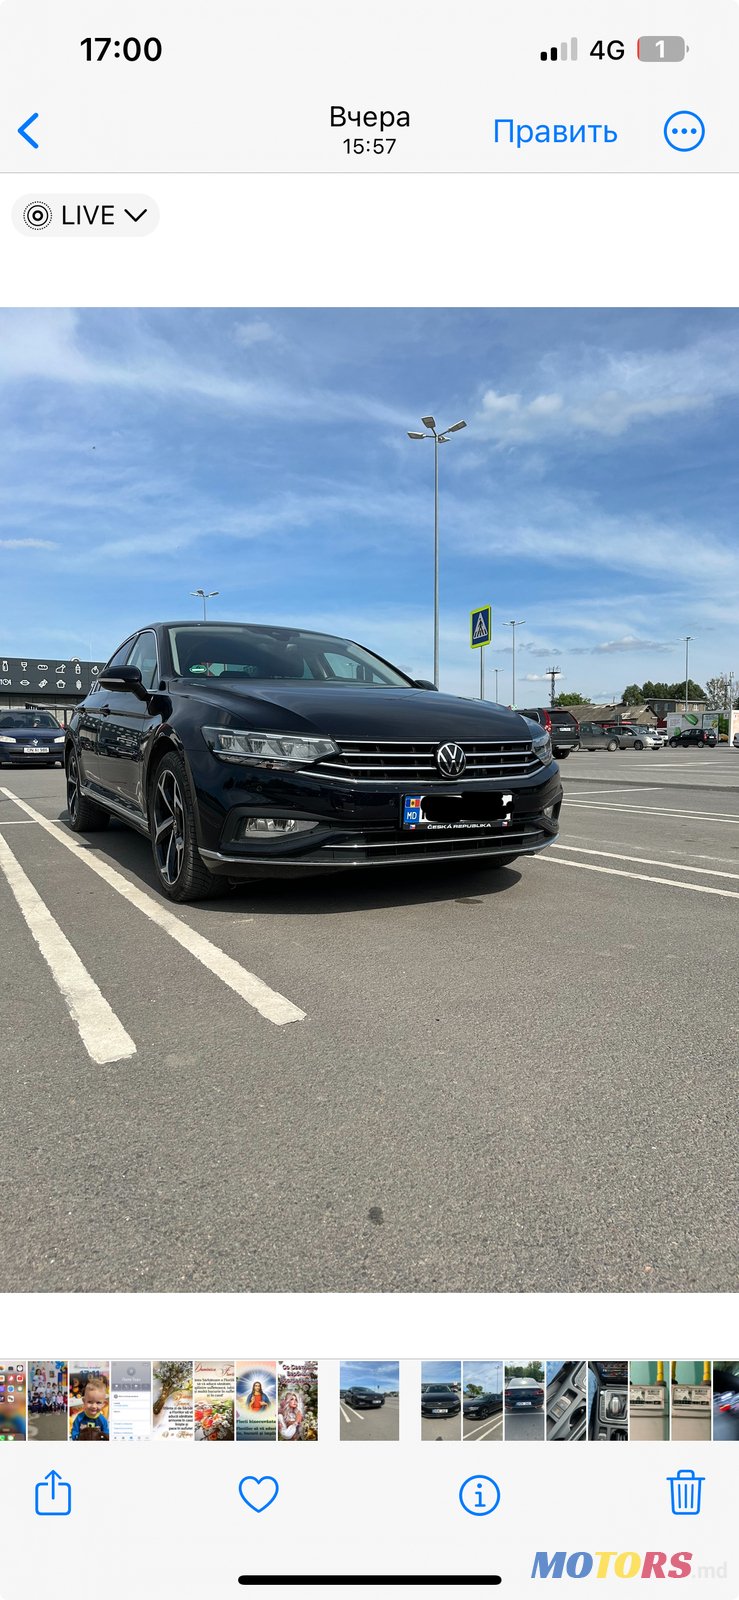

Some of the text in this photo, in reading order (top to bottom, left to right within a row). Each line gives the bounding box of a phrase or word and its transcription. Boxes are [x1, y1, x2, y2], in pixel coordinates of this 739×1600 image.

[80, 37, 163, 62] 17:00
[589, 39, 625, 61] 4G
[654, 40, 666, 59] 1
[330, 106, 411, 133] Вчера
[493, 118, 618, 147] Править
[342, 138, 397, 155] 15:57
[62, 205, 115, 225] LIVE
[406, 811, 418, 820] MD
